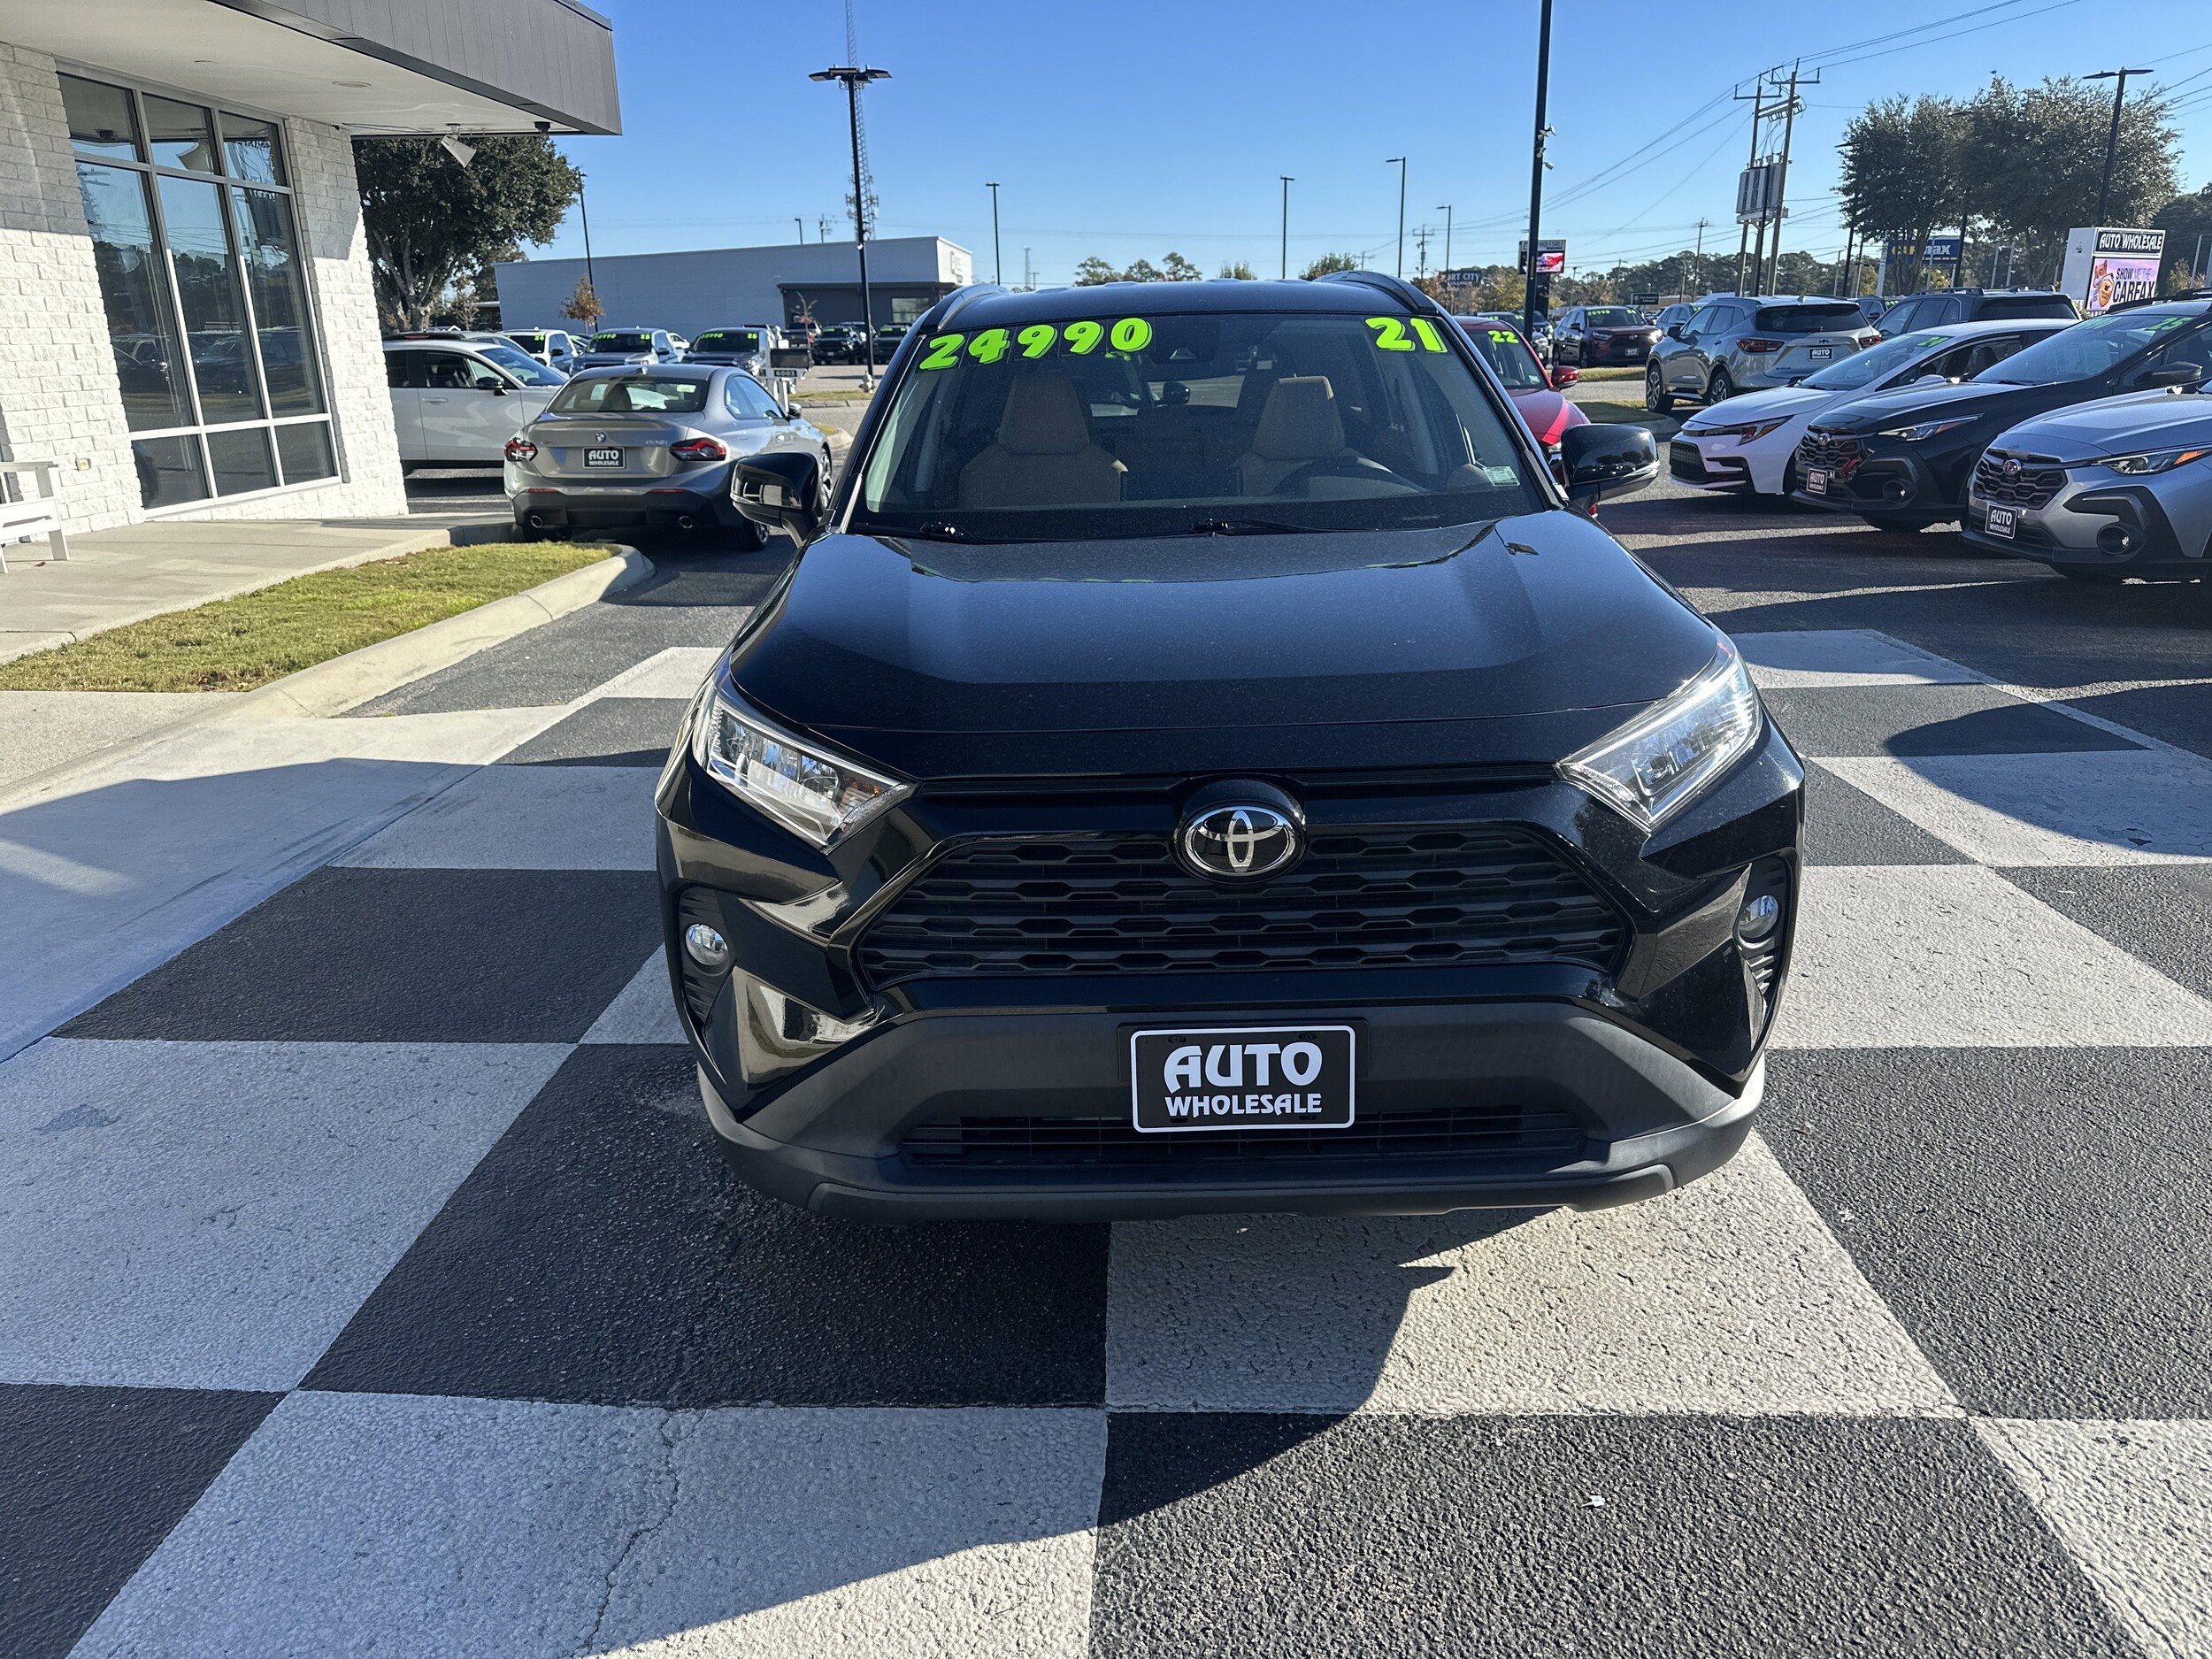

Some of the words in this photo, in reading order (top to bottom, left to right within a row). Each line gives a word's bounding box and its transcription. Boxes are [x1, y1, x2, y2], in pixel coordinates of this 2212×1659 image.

[2099, 233, 2121, 249] AUTO
[2122, 234, 2162, 251] WHOLESALE
[1463, 273, 1480, 282] CITY
[2116, 267, 2134, 280] SHOW
[2112, 280, 2155, 303] CARFAX
[2146, 317, 2193, 331] 25
[918, 317, 1153, 370] 24990
[1365, 316, 1448, 353] 21
[1487, 330, 1519, 343] 22
[588, 449, 619, 460] AUTO
[1809, 472, 1825, 484] AUTO
[1991, 510, 2013, 526] AUTO
[1164, 1041, 1323, 1094] AUTO
[1164, 1093, 1323, 1118] WHOLESALE
